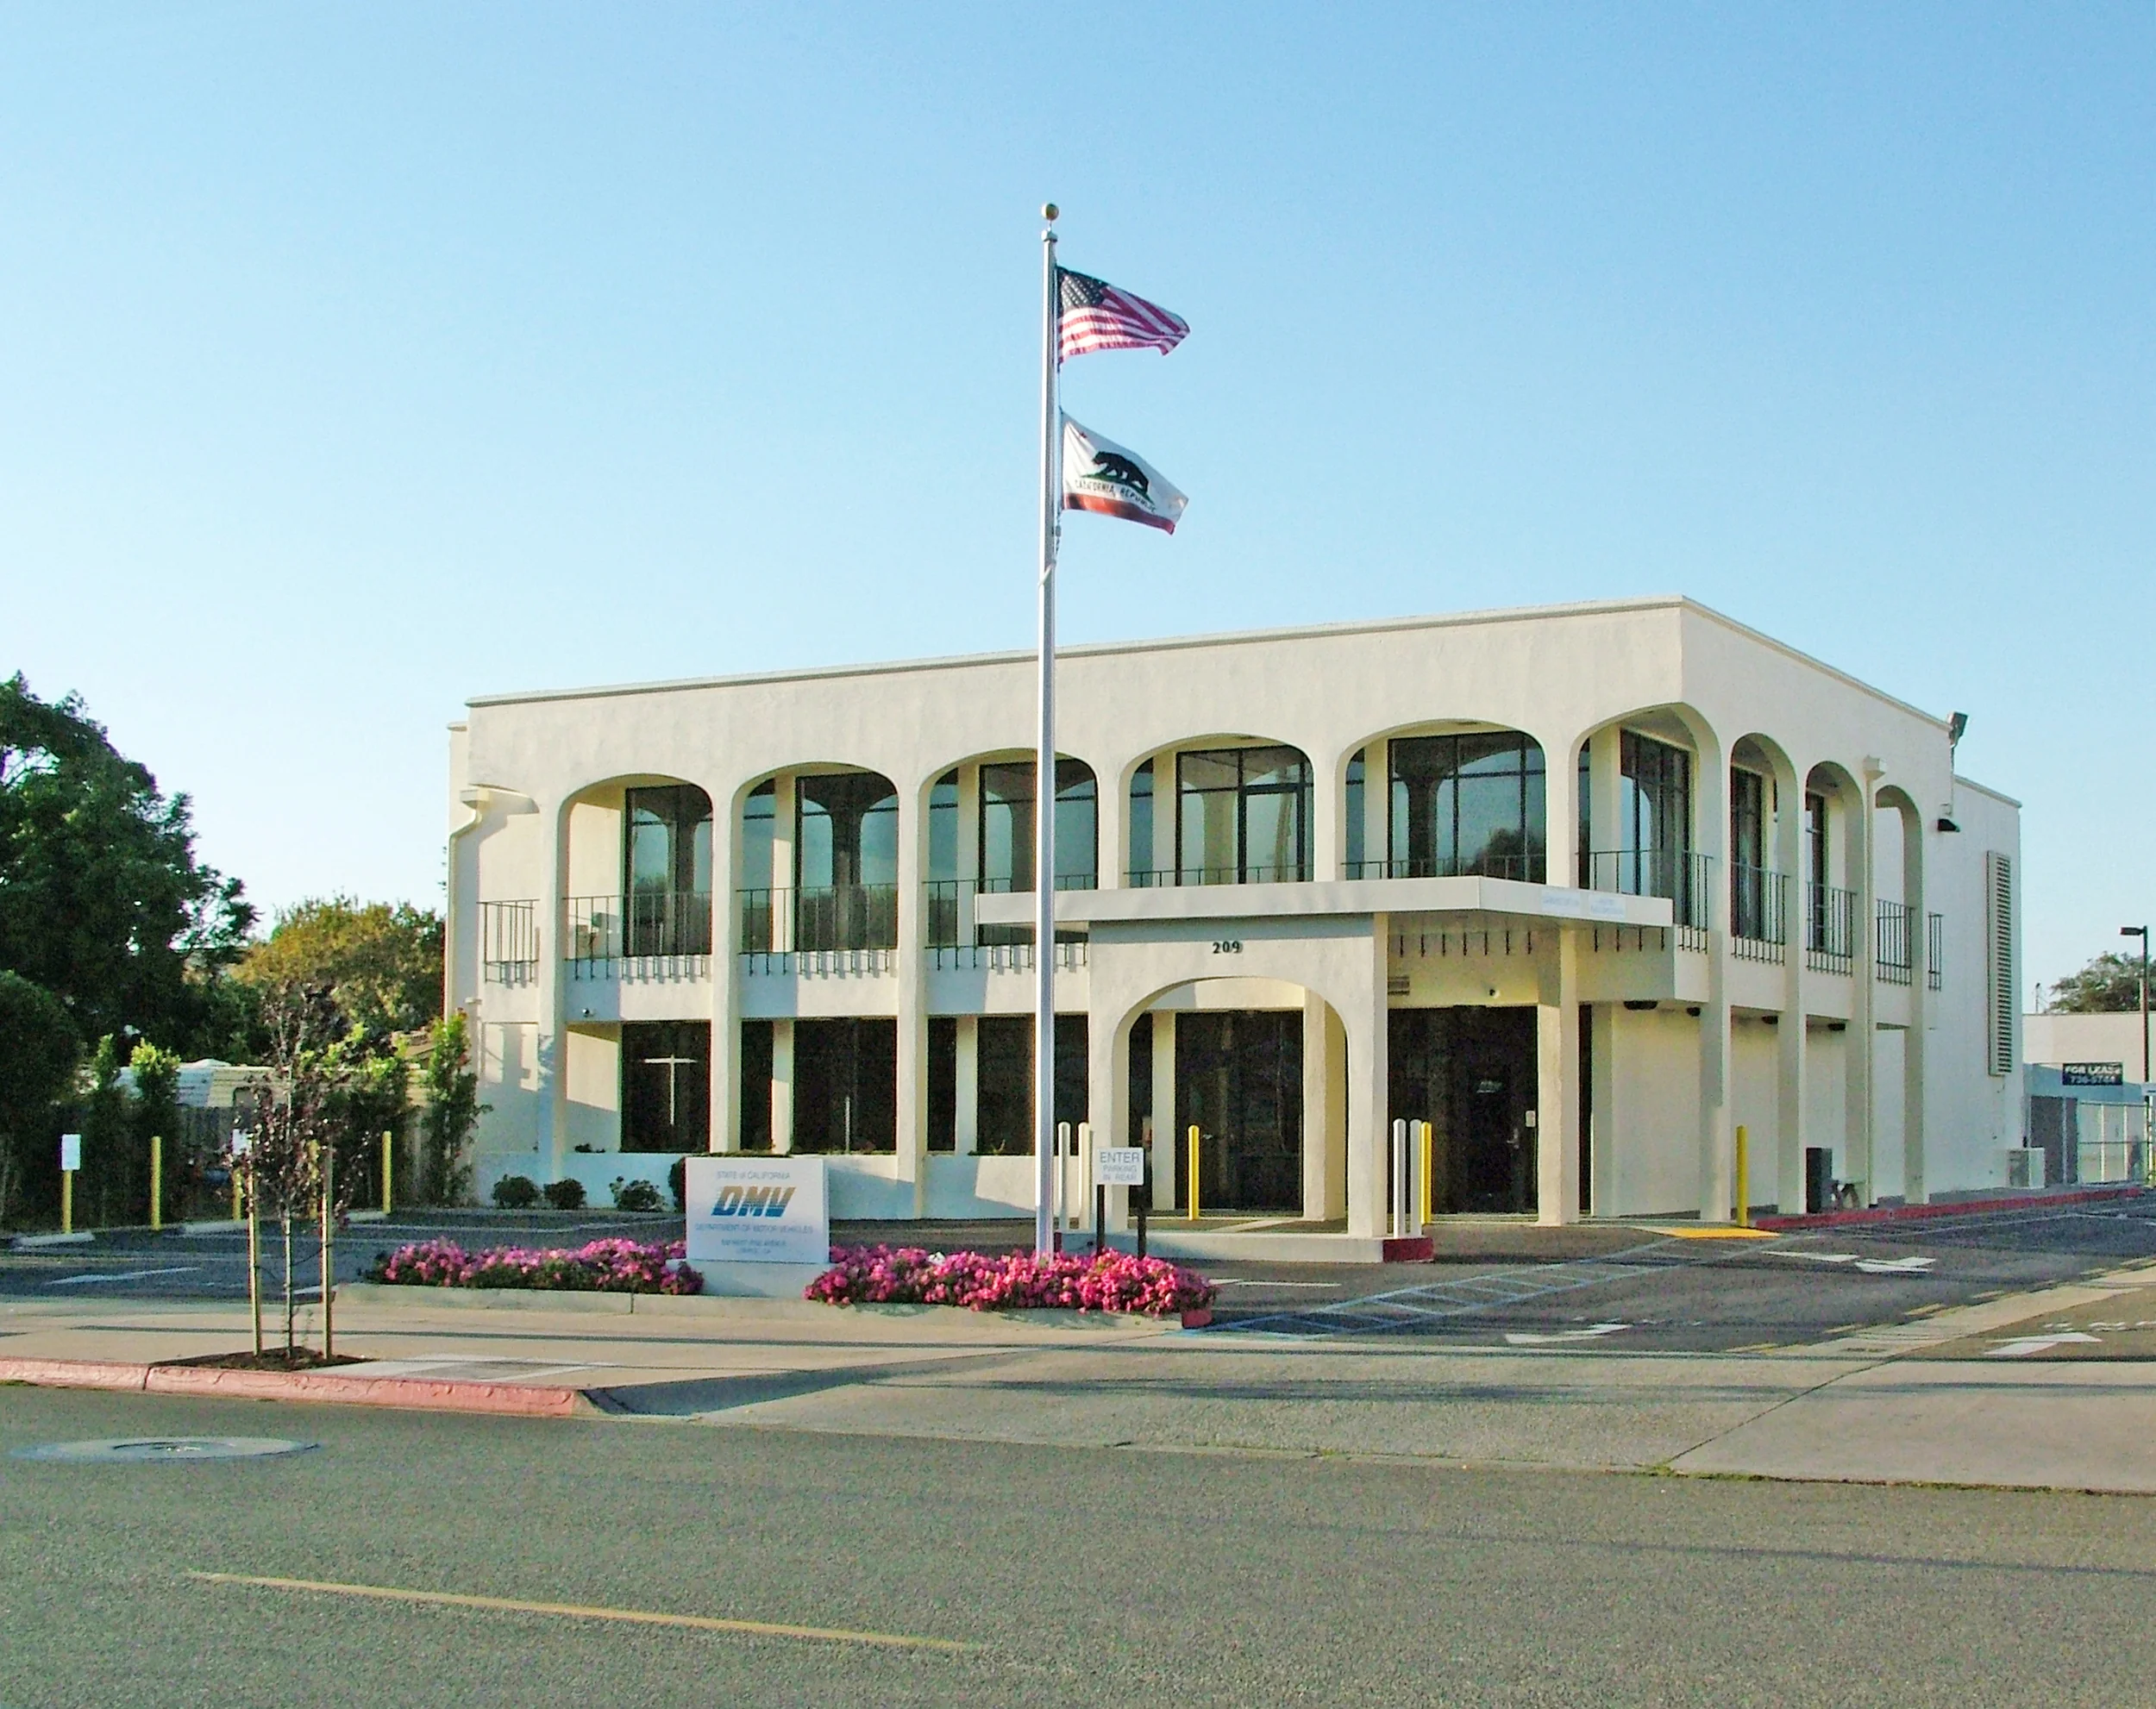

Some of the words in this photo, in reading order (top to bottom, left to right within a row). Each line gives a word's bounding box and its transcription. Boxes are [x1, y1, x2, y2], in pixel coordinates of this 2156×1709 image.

[1212, 941, 1241, 955] 209
[1100, 1152, 1140, 1163] ENTER
[748, 1170, 791, 1180] CALIFORNIA
[711, 1186, 797, 1218] DMV
